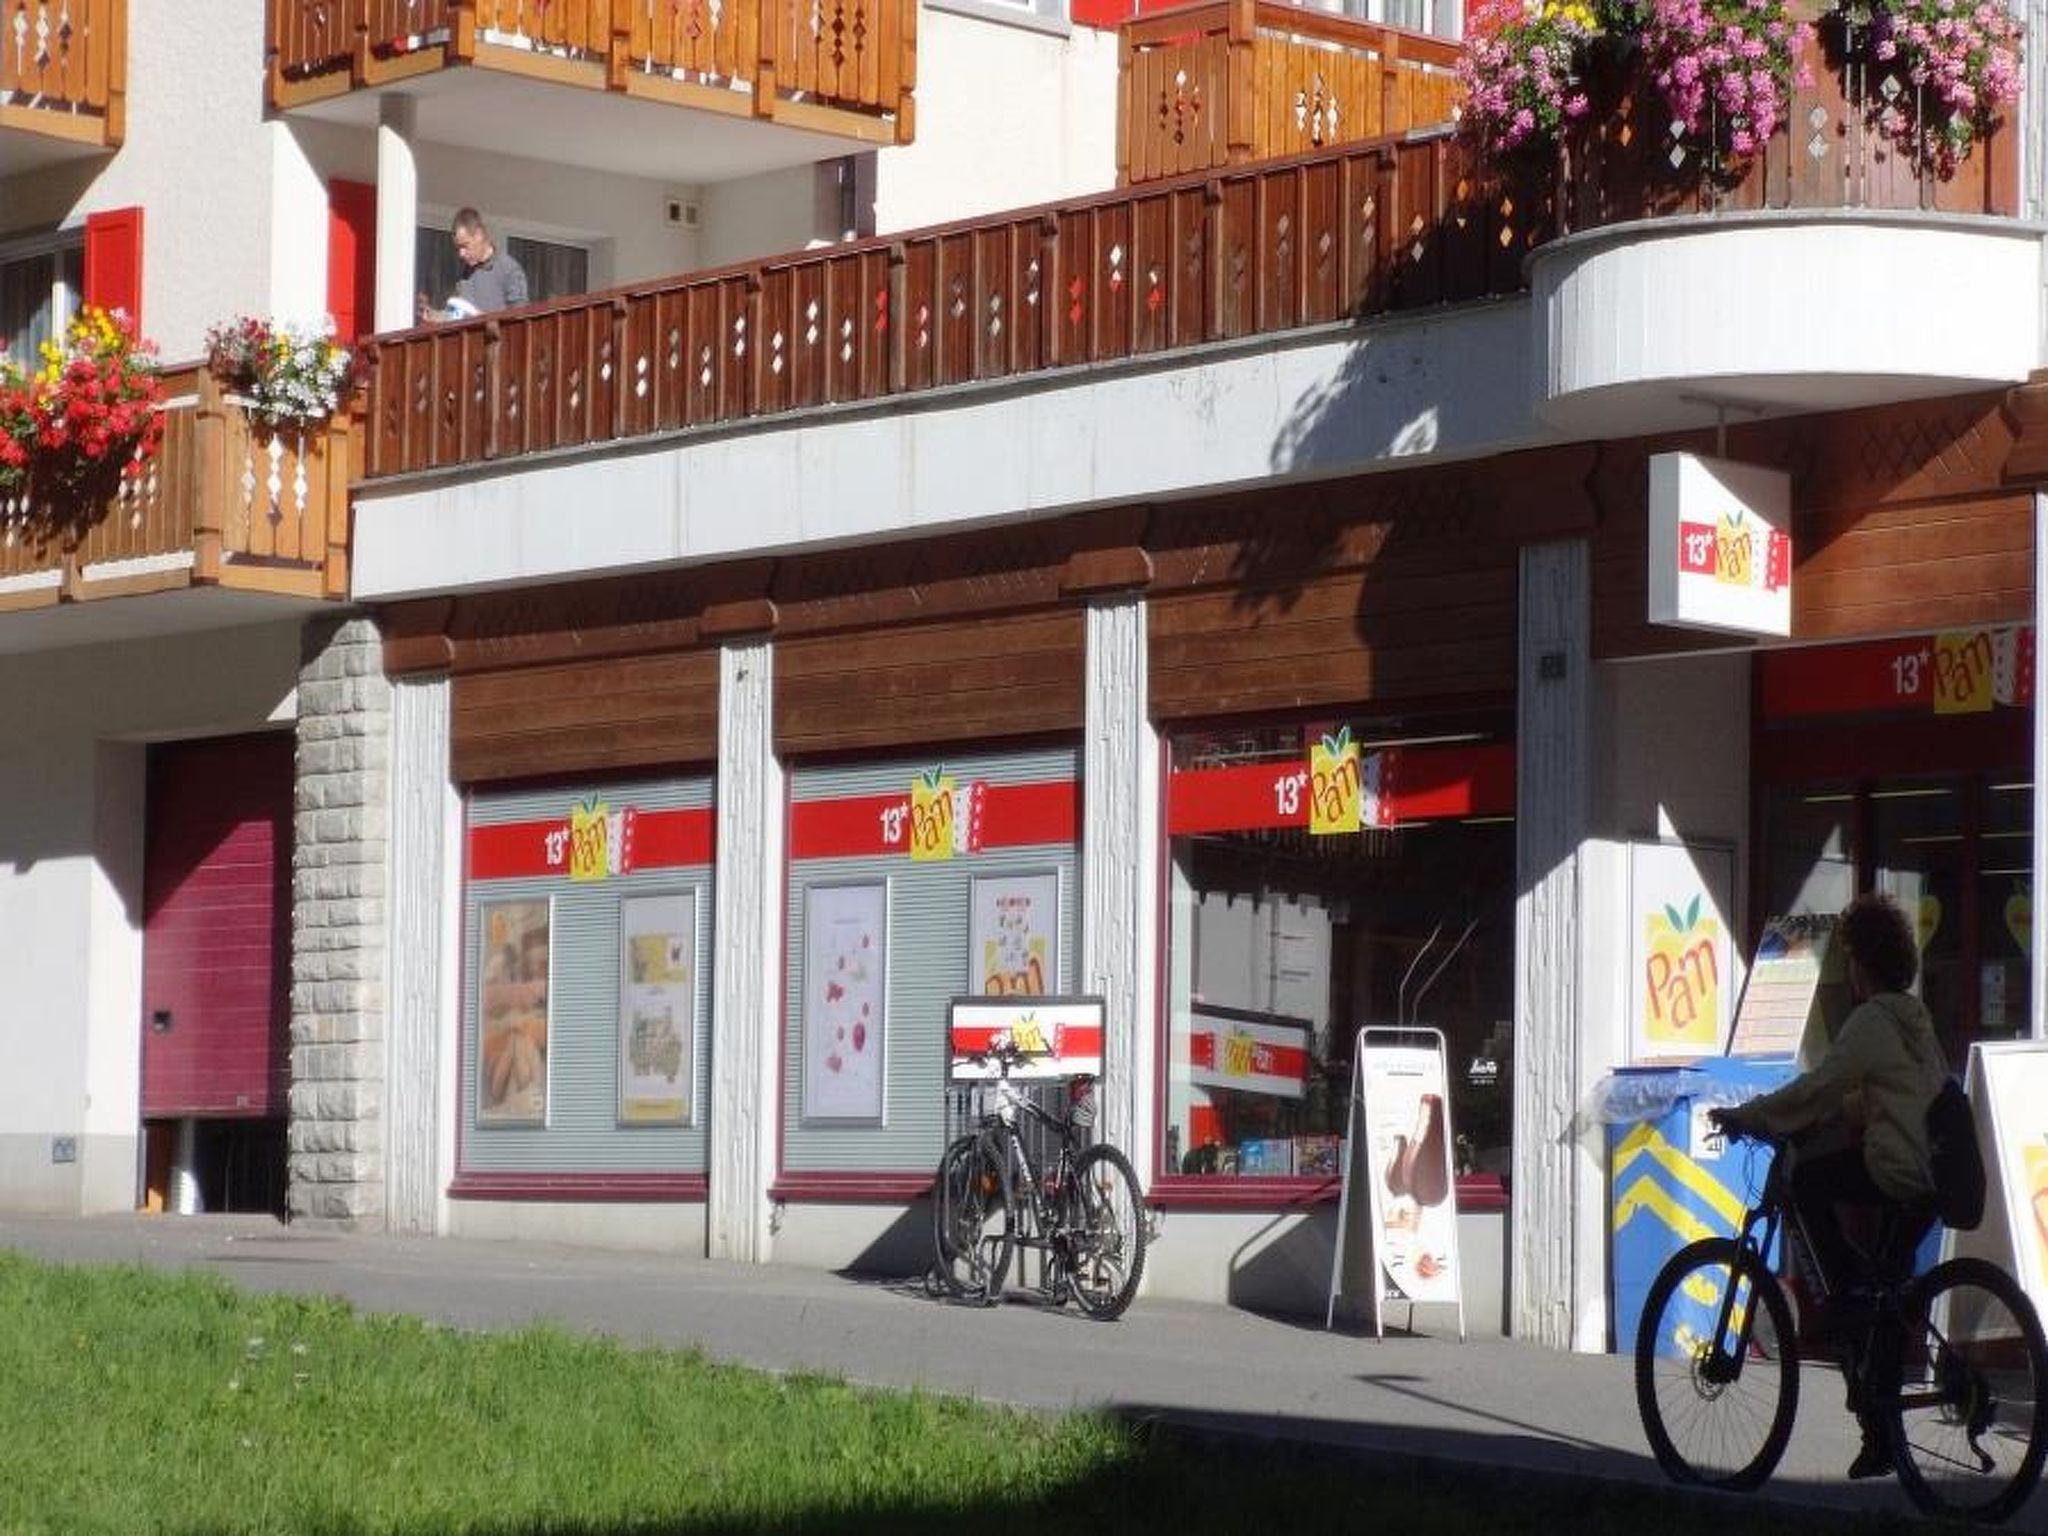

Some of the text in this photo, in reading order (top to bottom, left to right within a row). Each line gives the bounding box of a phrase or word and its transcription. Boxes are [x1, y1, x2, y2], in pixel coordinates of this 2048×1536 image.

[1715, 533, 1752, 578] Pam
[1935, 632, 1993, 702] Pam
[912, 790, 953, 851] Pam
[1311, 757, 1360, 823] Pam
[1646, 938, 1718, 1029] Pam
